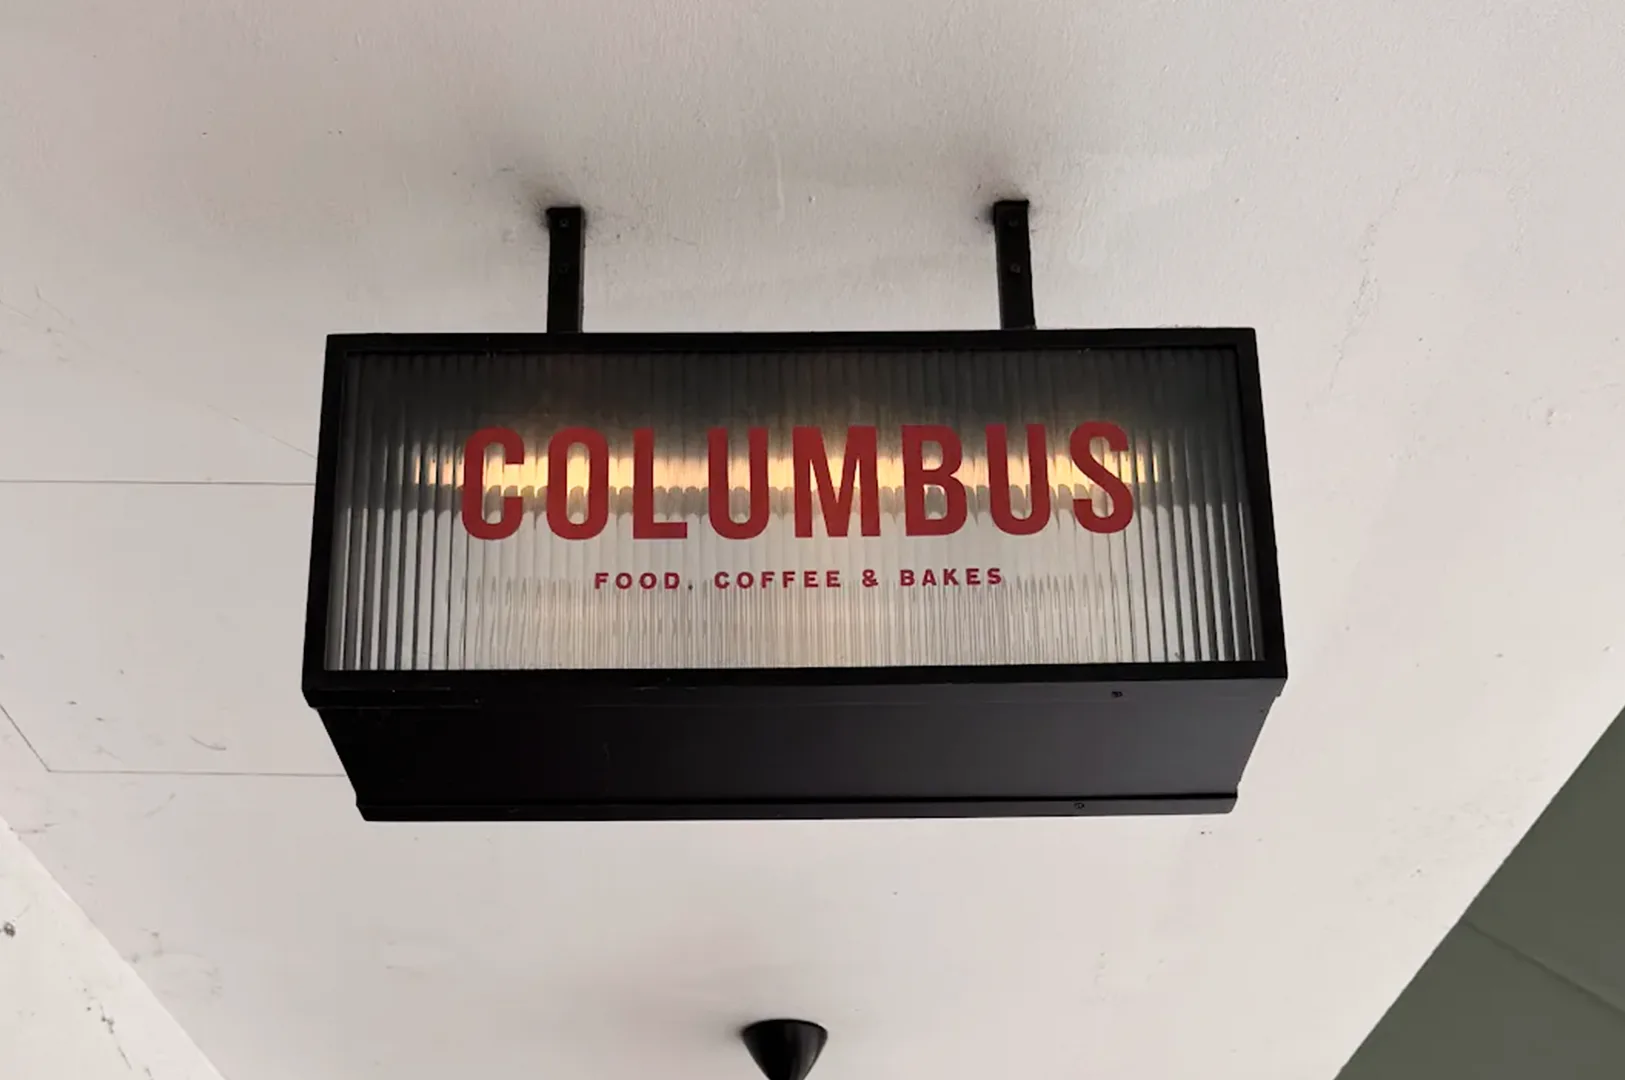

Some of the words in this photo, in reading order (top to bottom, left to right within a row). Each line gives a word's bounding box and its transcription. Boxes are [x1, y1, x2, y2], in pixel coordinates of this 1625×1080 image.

[460, 420, 1135, 541] COLUMBUS
[714, 570, 841, 590] COFFEE
[861, 569, 879, 588] &
[899, 568, 1002, 587] BAKES
